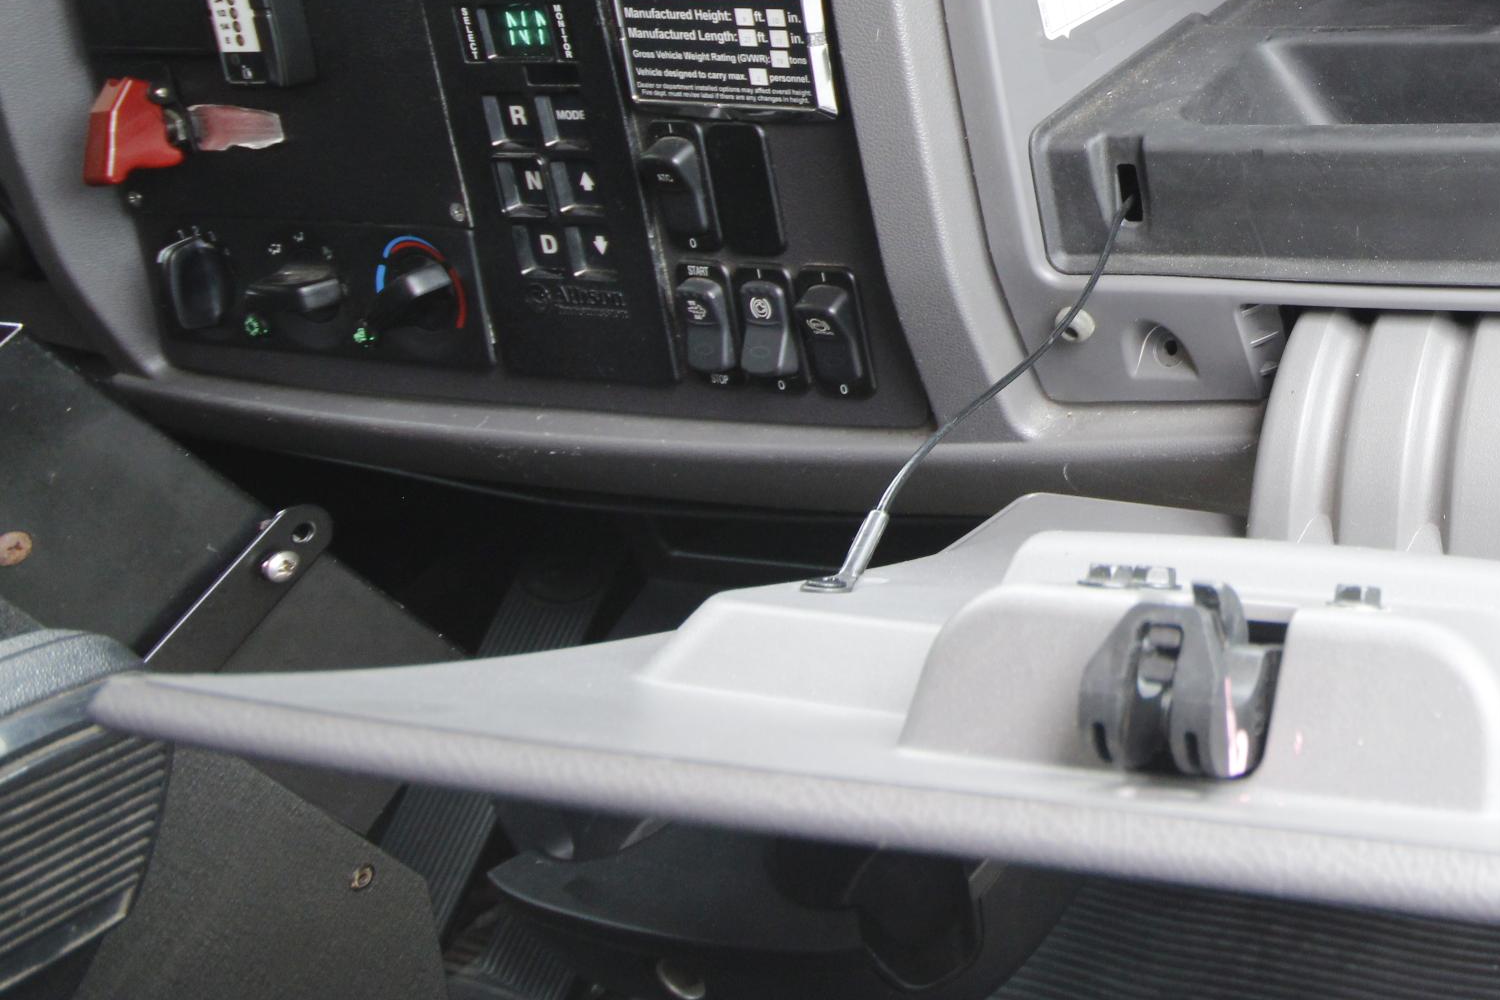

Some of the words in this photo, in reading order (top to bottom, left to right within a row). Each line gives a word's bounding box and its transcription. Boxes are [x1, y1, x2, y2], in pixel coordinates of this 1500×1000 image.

[624, 7, 693, 19] Manufactured
[694, 9, 732, 24] Height:
[461, 7, 478, 59] SELECT
[553, 4, 573, 58] MONITOR
[628, 28, 696, 40] Manufactured
[698, 30, 738, 44] Length:
[633, 50, 655, 58] Gross
[656, 50, 682, 59] Vehicle
[683, 51, 709, 62] Weight
[711, 53, 736, 64] Rating
[789, 56, 807, 64] tons
[635, 68, 662, 76] Vehicle
[664, 69, 697, 79] designed
[707, 70, 726, 81] carry
[769, 75, 810, 83] personnel.
[509, 105, 527, 125] R
[556, 109, 585, 121] MODE
[525, 171, 543, 190] N
[540, 234, 557, 254] D
[687, 265, 709, 276] START
[711, 374, 728, 384] STOP
